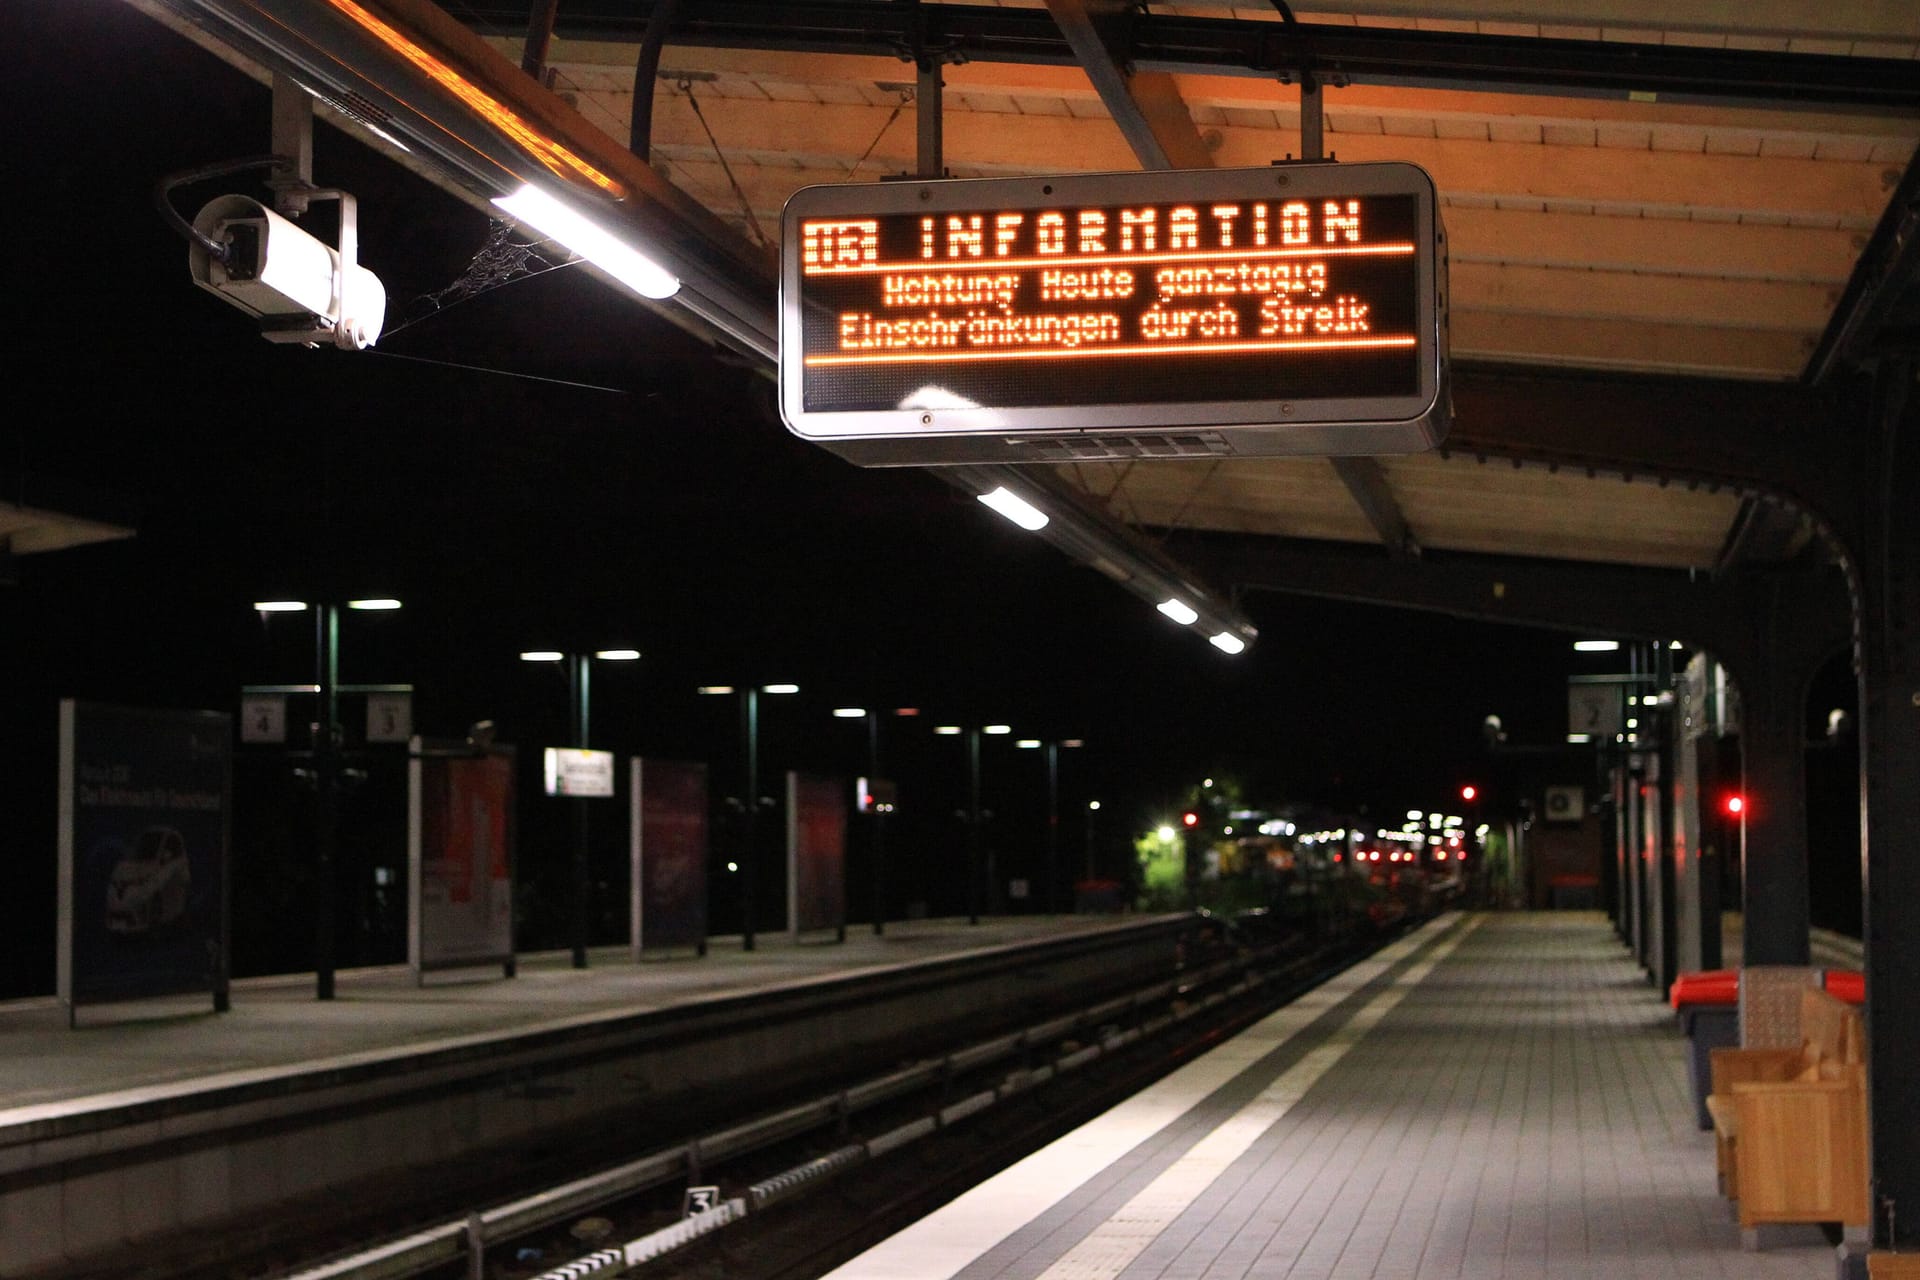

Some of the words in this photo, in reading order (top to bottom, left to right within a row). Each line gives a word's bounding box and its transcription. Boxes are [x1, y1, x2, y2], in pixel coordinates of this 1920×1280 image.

[920, 201, 1360, 258] INFORMATION
[1042, 267, 1133, 301] Heute
[840, 309, 1120, 348] Einschränkungen
[1141, 301, 1238, 338] durch
[1260, 297, 1369, 335] Streik
